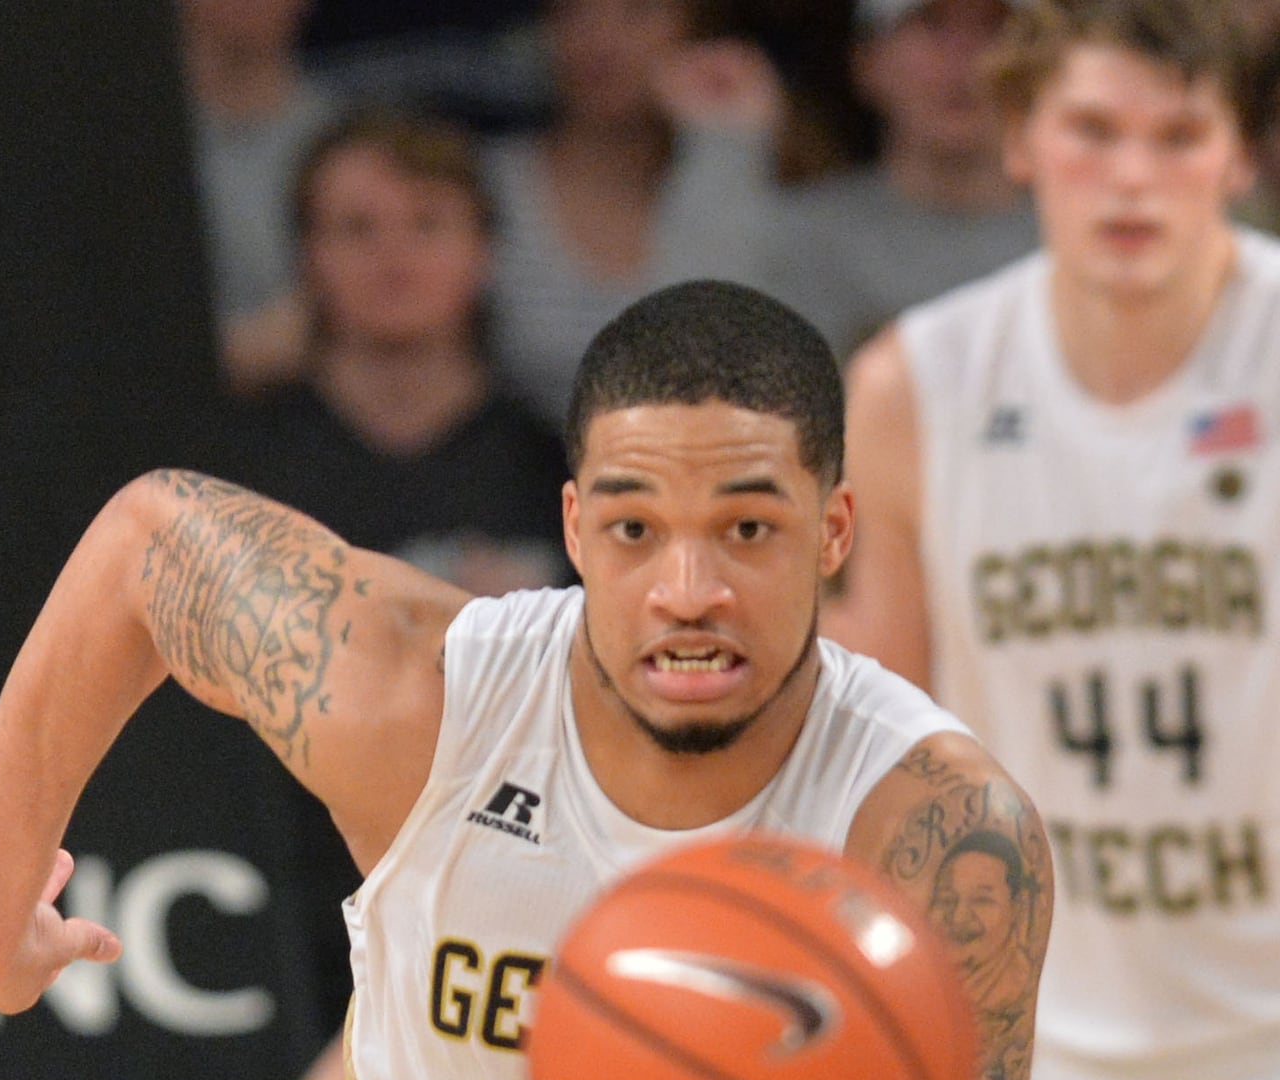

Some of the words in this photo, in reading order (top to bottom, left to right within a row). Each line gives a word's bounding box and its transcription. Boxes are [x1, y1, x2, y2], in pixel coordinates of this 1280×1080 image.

[970, 538, 1267, 648] GEORGIA
[1042, 660, 1208, 790] 44
[467, 810, 541, 845] RUSSELL
[1048, 816, 1269, 918] TECH
